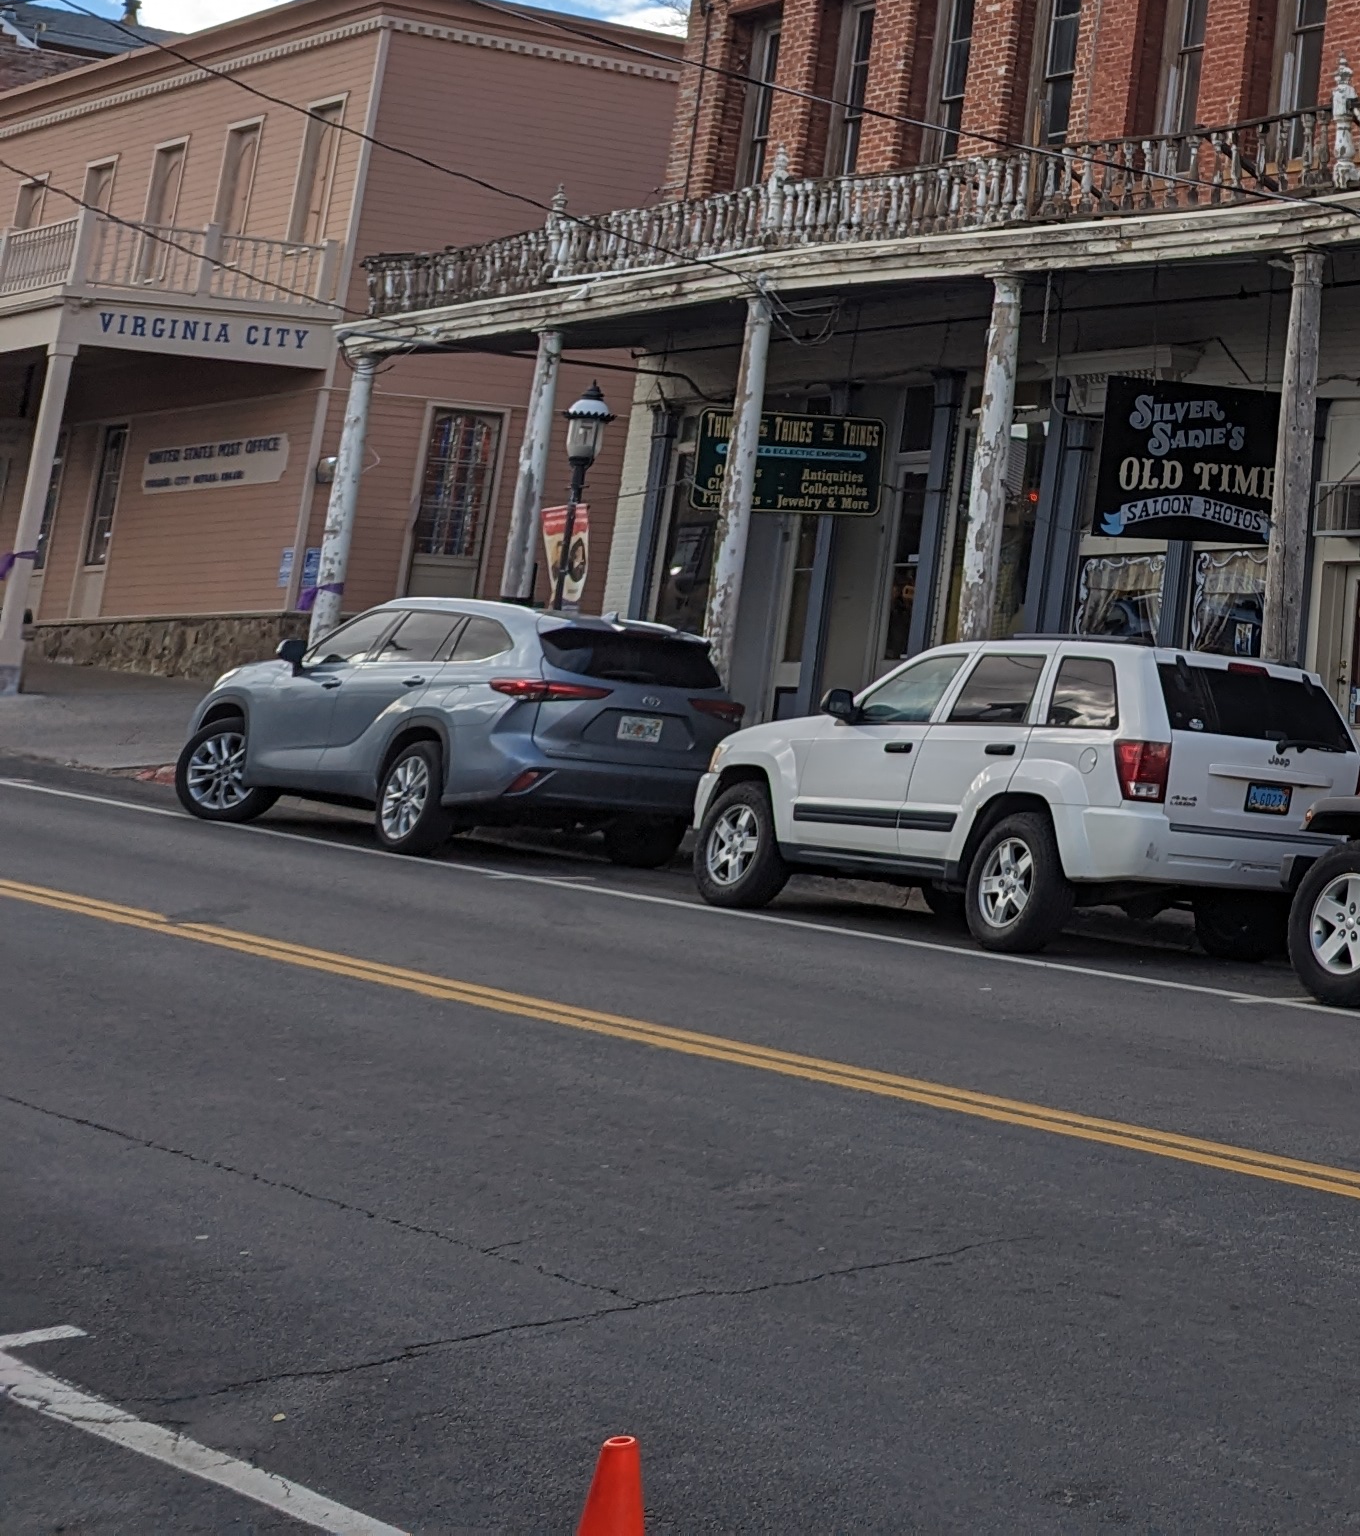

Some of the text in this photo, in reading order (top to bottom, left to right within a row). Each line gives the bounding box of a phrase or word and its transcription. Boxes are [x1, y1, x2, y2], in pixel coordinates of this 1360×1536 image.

[99, 312, 310, 349] VIRGINIA CITY
[1129, 394, 1226, 430] SILVER
[245, 437, 282, 454] OFFICE
[708, 413, 733, 438] THIN
[775, 417, 814, 443] THINGS
[843, 421, 880, 447] THINGS
[1148, 421, 1246, 456] SADIE'S
[800, 482, 868, 496] Collectables
[802, 468, 864, 484] Antiquities
[1119, 456, 1184, 491] OLD
[777, 494, 822, 510] Jewelry
[826, 496, 836, 508] &
[841, 497, 870, 510] More
[1126, 497, 1261, 531] SALOON PHOTOS
[1268, 755, 1291, 768] Jeep
